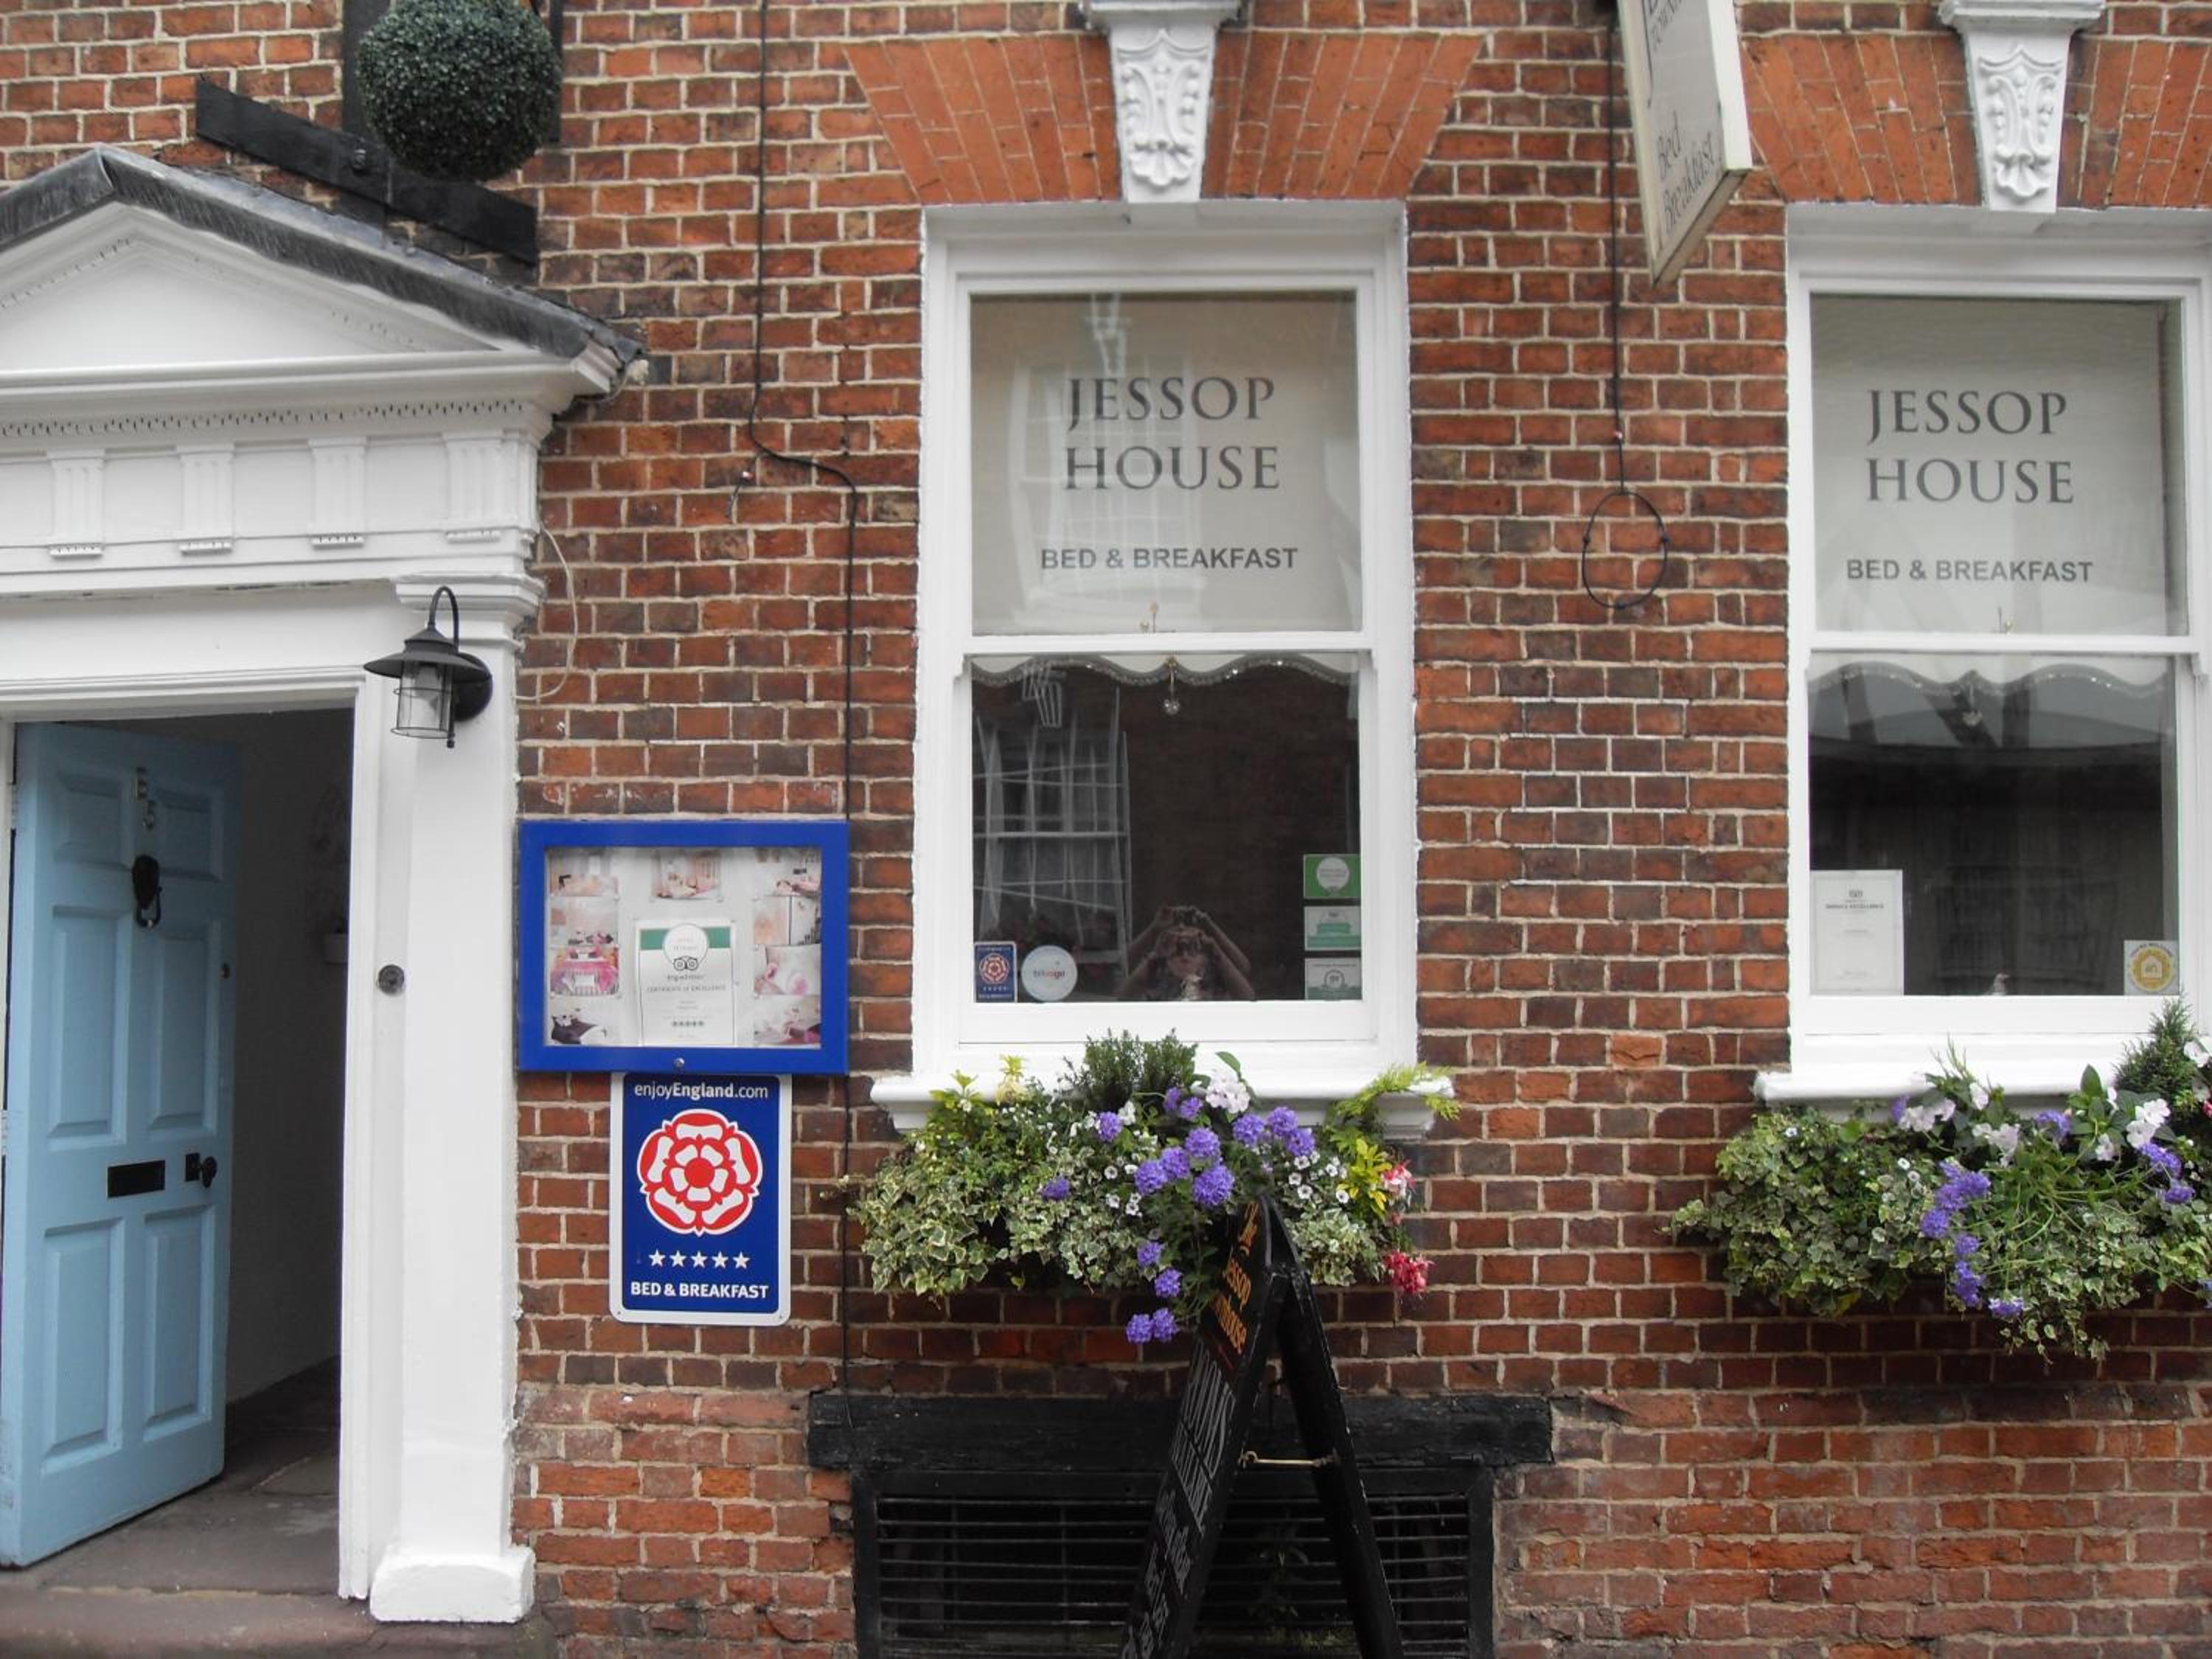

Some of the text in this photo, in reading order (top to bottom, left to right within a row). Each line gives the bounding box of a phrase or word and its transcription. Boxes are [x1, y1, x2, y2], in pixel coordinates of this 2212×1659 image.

[1067, 376, 1275, 434] JESSOP
[1866, 389, 2067, 446] JESSOP
[1065, 445, 1280, 490] HOUSE
[1865, 457, 2074, 504] HOUSE
[1040, 547, 1298, 569] BED & BREAKFAST
[1846, 559, 2093, 582] BED & BREAKFAST
[634, 1081, 768, 1101] enjoyEngland.com
[630, 1281, 769, 1299] BED & BREAKFAST
